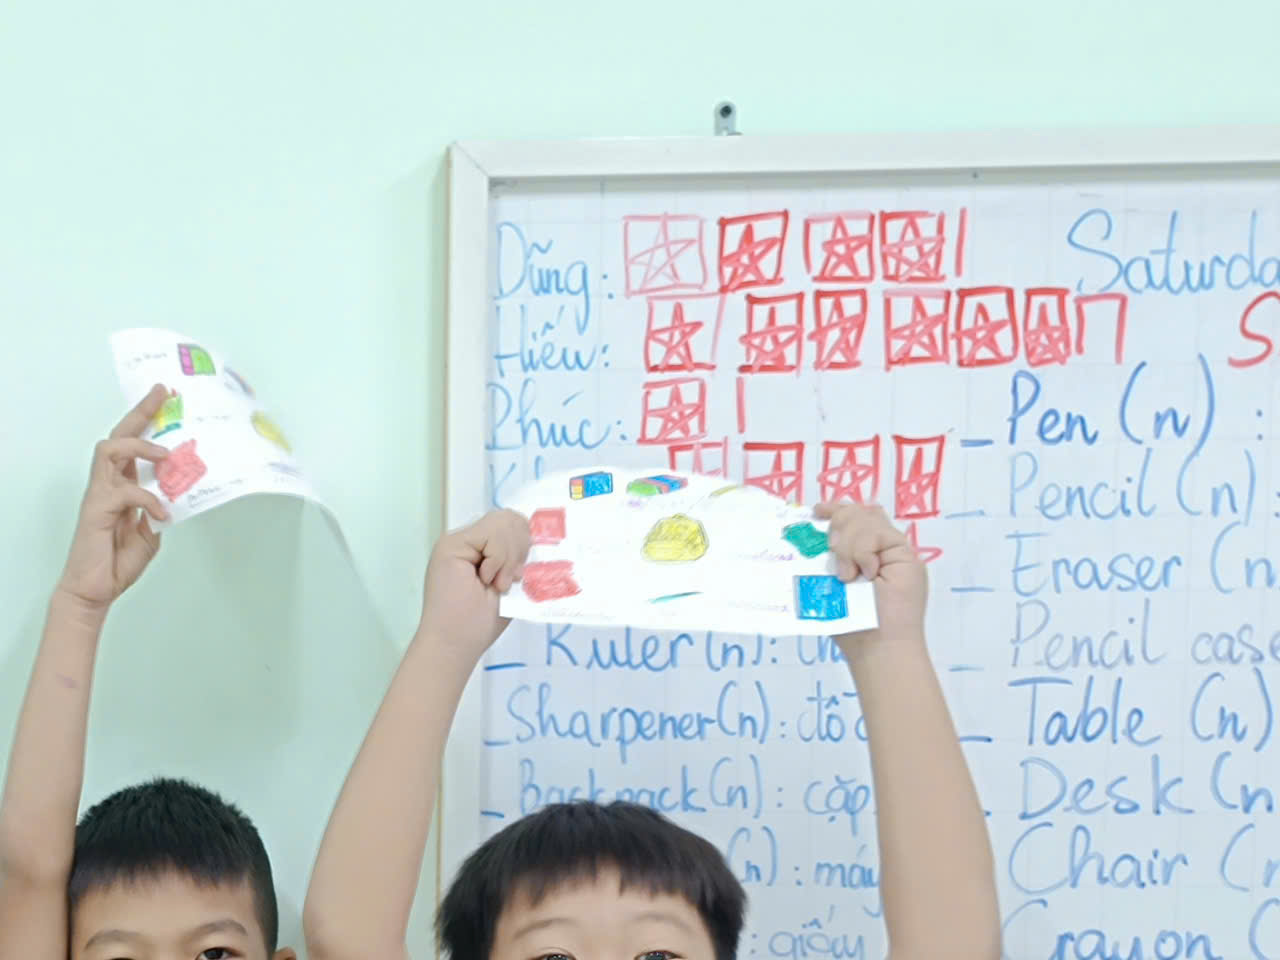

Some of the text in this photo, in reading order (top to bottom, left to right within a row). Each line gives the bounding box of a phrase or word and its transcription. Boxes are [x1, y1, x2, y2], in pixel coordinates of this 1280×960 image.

[1006, 369, 1099, 447] Pen
[1008, 447, 1157, 521] Pencil
[1004, 530, 1183, 598] Eraser
[1009, 597, 1168, 671] Pencil
[1007, 674, 1163, 748] Table
[1017, 753, 1196, 821] Desk
[1008, 820, 1189, 896] Chair
